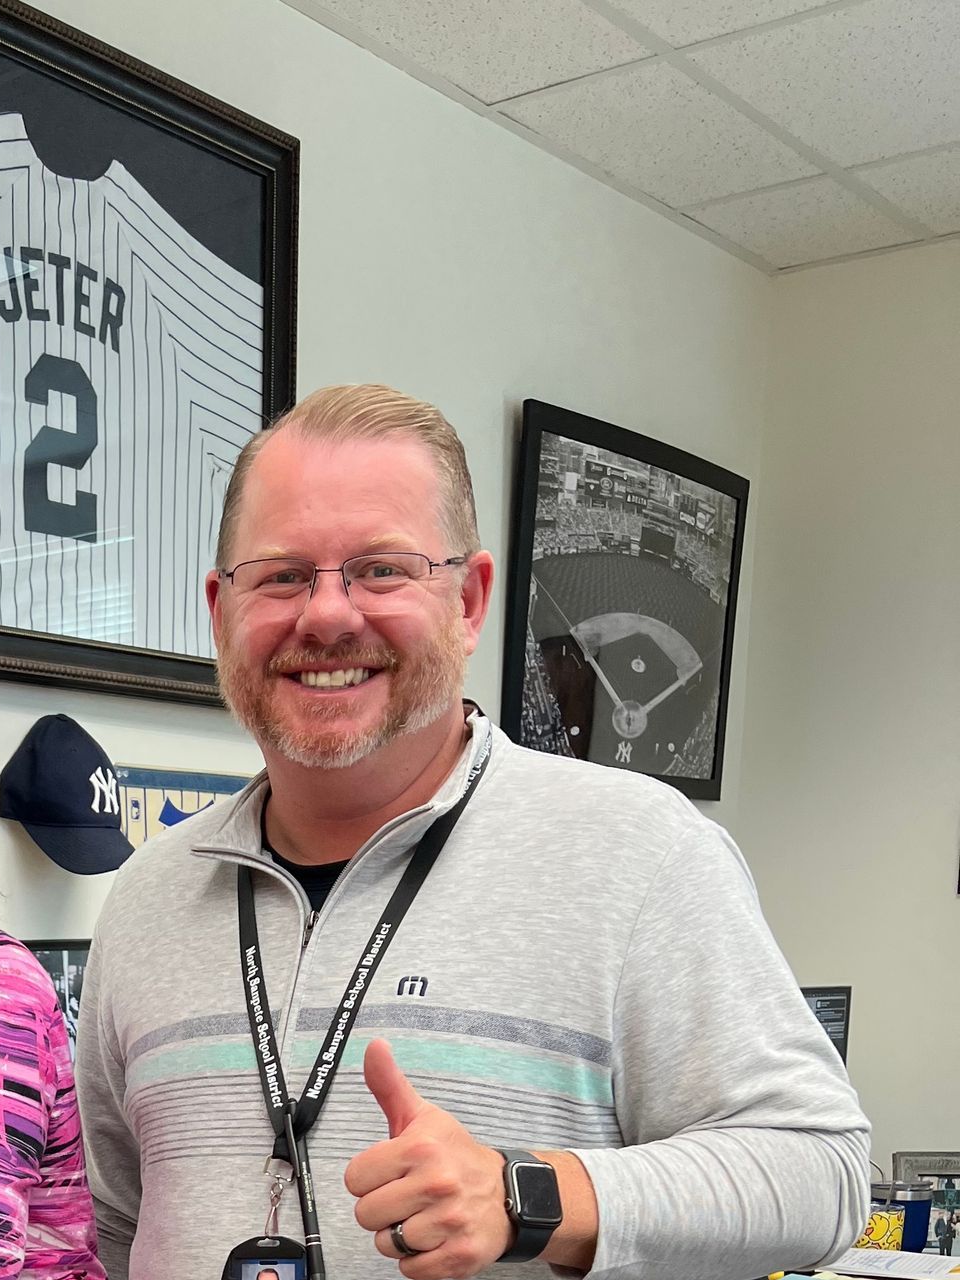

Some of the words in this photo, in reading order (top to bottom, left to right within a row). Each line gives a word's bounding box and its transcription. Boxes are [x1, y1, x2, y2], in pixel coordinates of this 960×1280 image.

[24, 353, 98, 543] 2
[89, 766, 119, 815] NY
[245, 945, 259, 981] North
[249, 977, 263, 1022] Sanpete
[306, 1061, 334, 1099] North
[322, 1011, 350, 1062] Sanpete
[344, 968, 369, 1009] School
[361, 923, 391, 966] District
[258, 1023, 275, 1063] School
[265, 1063, 283, 1108] District
